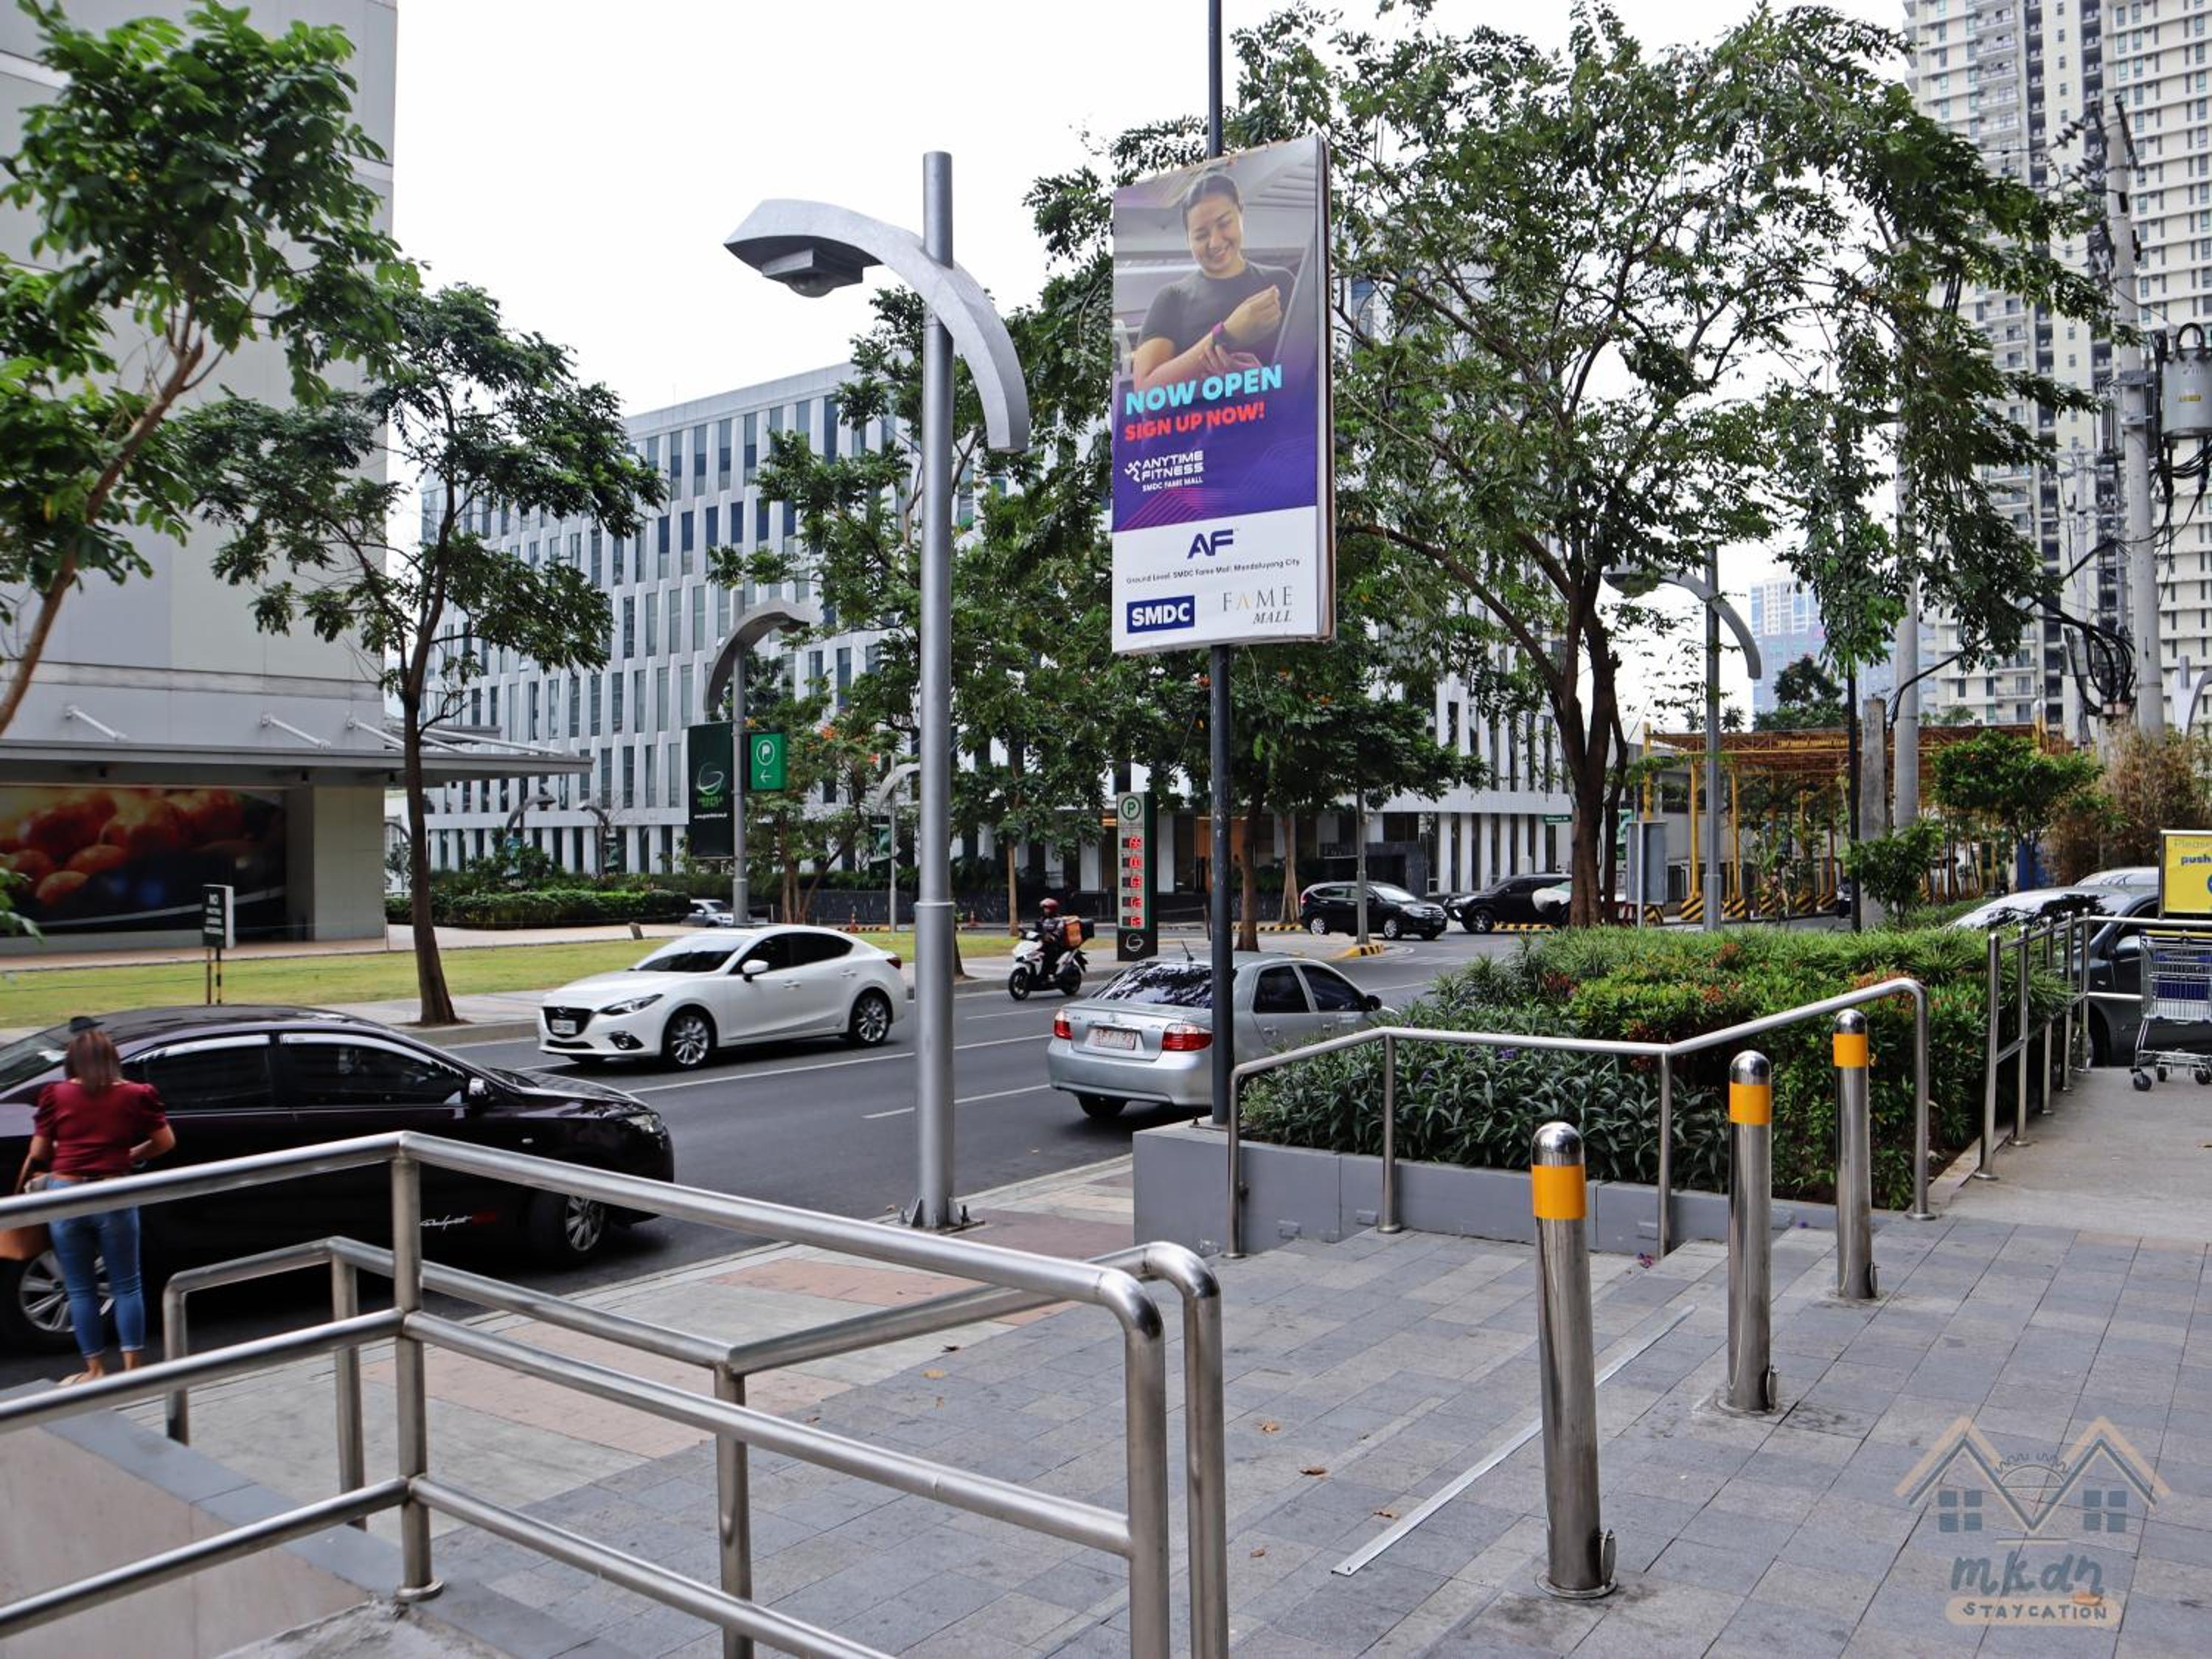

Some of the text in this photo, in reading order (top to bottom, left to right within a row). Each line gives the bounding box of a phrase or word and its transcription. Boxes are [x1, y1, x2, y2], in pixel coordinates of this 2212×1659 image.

[1126, 364, 1282, 416] NOW OPEN
[1124, 401, 1265, 442] SIGN UP NOW!
[1142, 450, 1204, 470] ANYTIME
[1142, 462, 1204, 481] FITNESS
[1142, 481, 1163, 493] SMDC
[1184, 476, 1203, 487] MALL
[1186, 529, 1234, 559] AF
[1173, 570, 1194, 579] SMDC
[1285, 558, 1300, 566] City
[1223, 585, 1293, 612] FAME
[1131, 602, 1191, 627] SMDC
[1253, 610, 1293, 625] MALL
[762, 744, 771, 760] P
[1127, 801, 1136, 815] P
